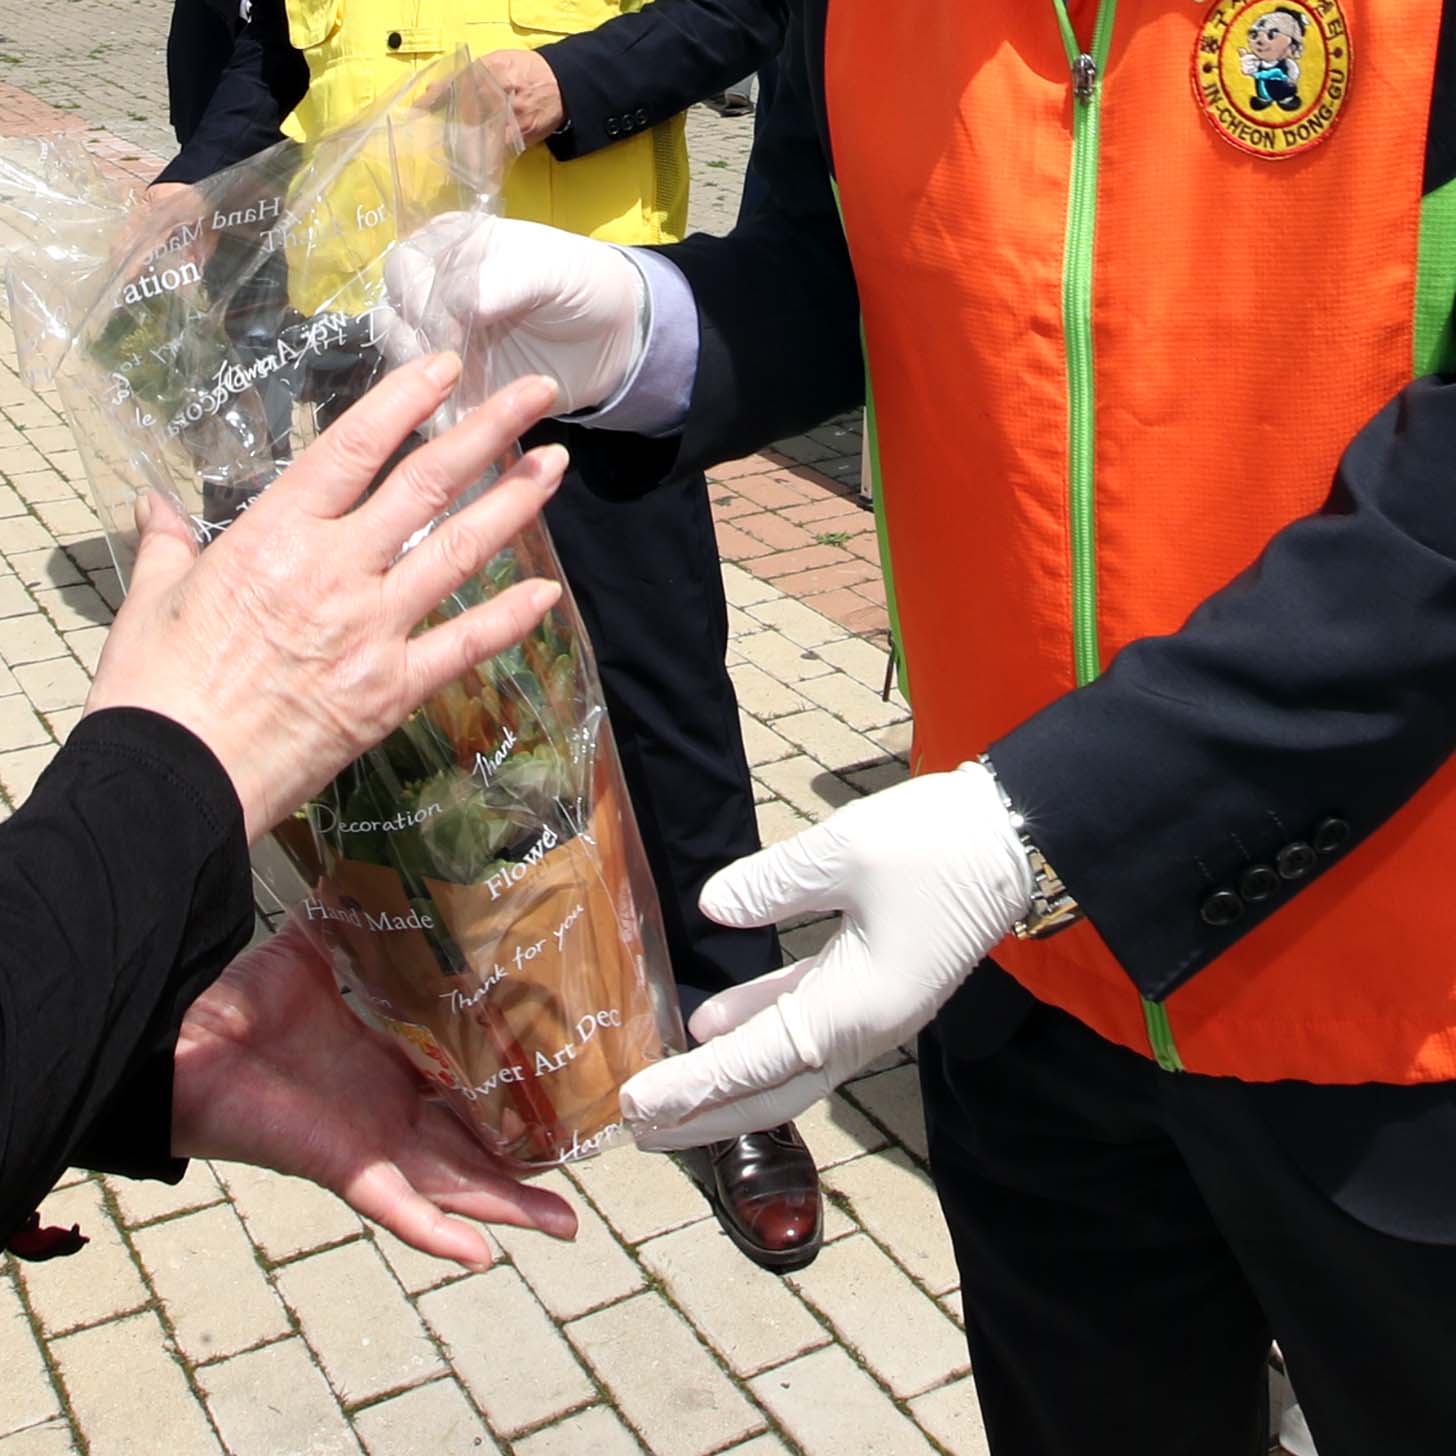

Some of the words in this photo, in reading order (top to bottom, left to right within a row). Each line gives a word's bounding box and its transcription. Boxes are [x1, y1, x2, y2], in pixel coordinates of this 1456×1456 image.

[1203, 83, 1276, 148] IN-CHEON
[1283, 67, 1346, 148] DONG-GU
[355, 202, 387, 232] for
[113, 260, 202, 307] ation
[472, 725, 518, 787] Thank
[308, 799, 443, 835] Decoration
[303, 895, 362, 928] Hand
[362, 907, 436, 933] Made
[439, 963, 509, 1016] Thank
[510, 936, 547, 972] for
[552, 903, 586, 953] you
[455, 1067, 527, 1102] ower
[533, 1042, 579, 1079] Art
